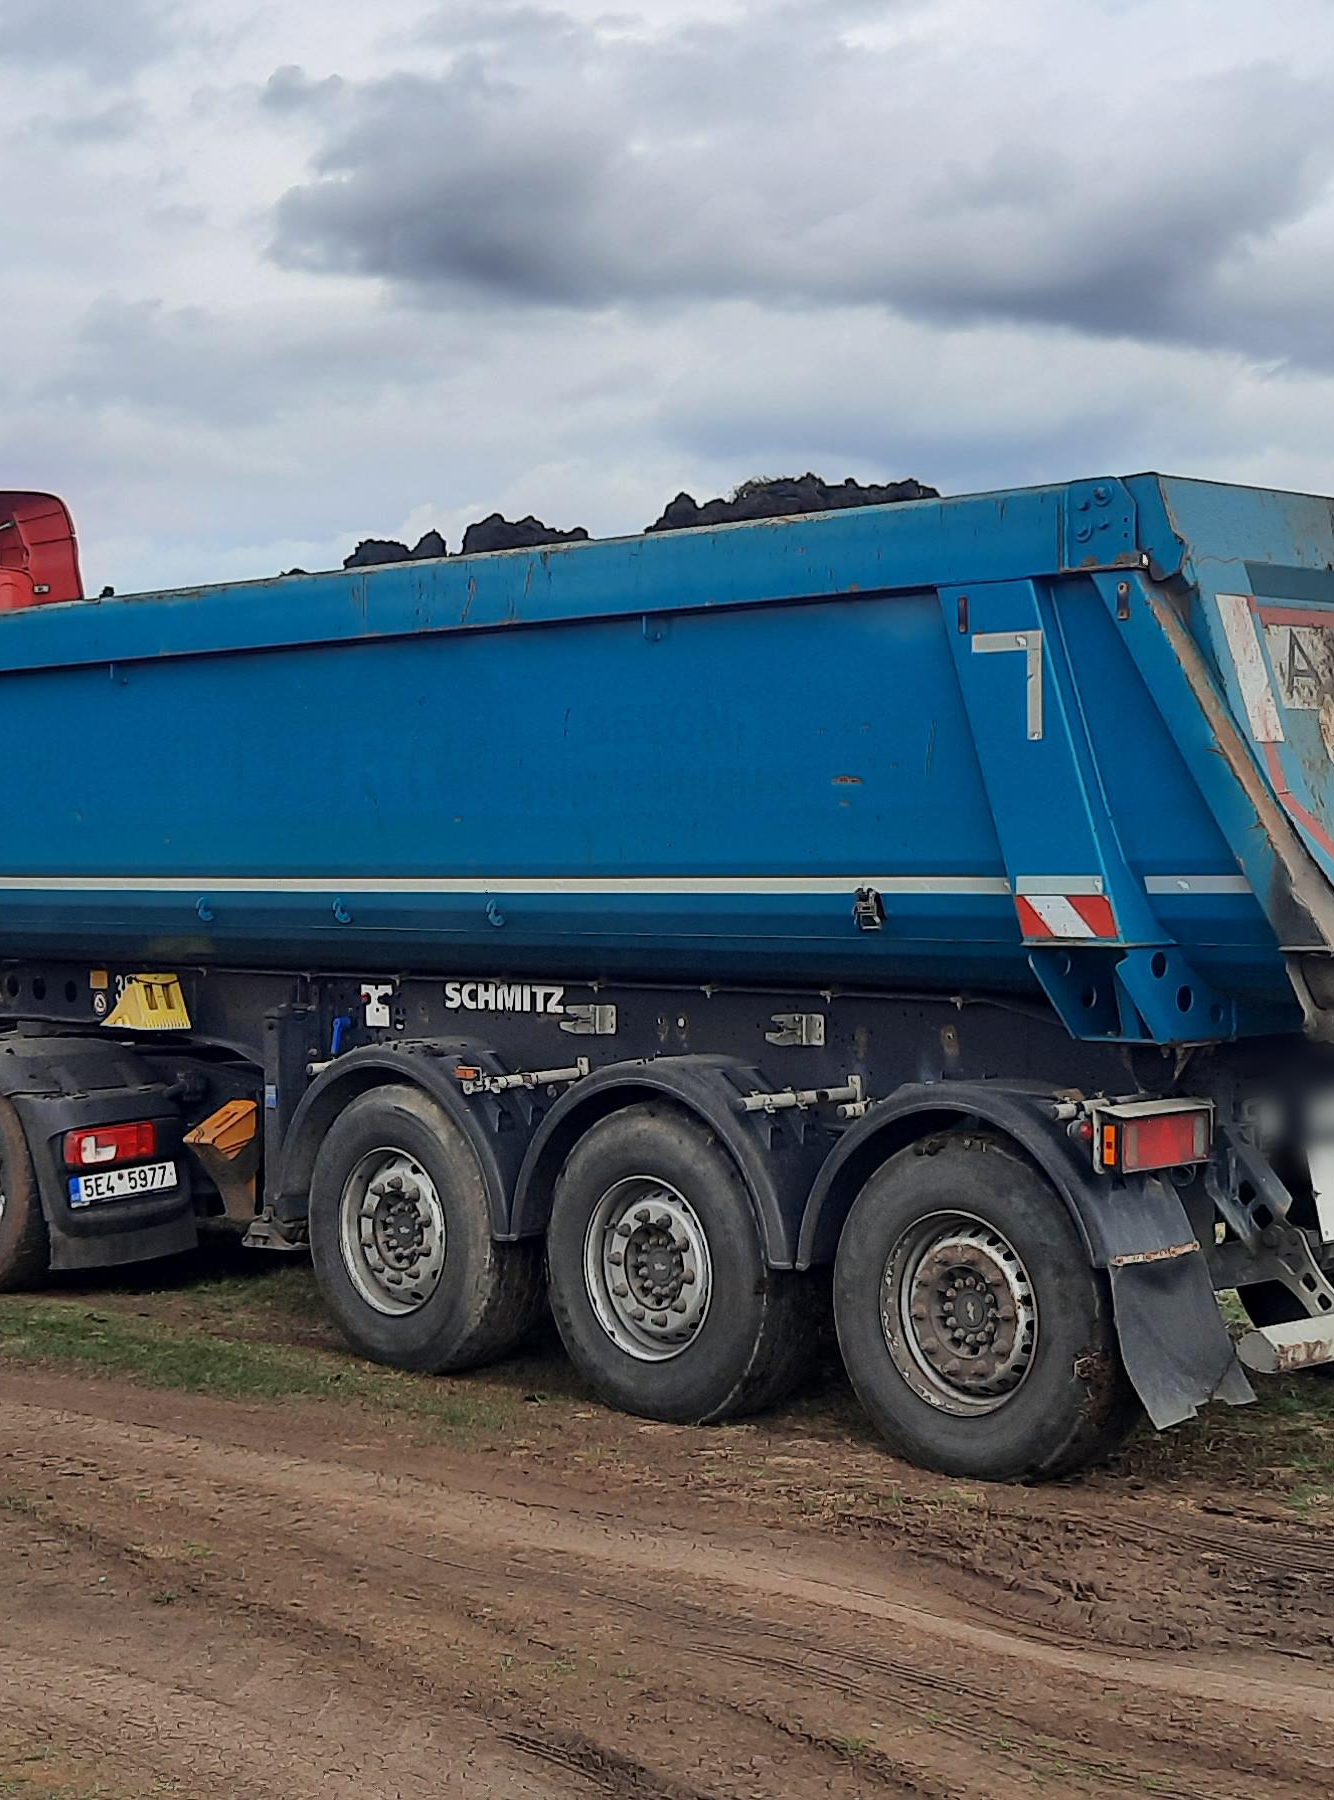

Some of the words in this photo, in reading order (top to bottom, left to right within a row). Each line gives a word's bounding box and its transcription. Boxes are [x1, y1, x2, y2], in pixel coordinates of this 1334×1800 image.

[1286, 628, 1324, 695] A
[445, 982, 564, 1014] SCHMITZ
[83, 1175, 116, 1198] 5E4
[127, 1165, 167, 1190] 5977
